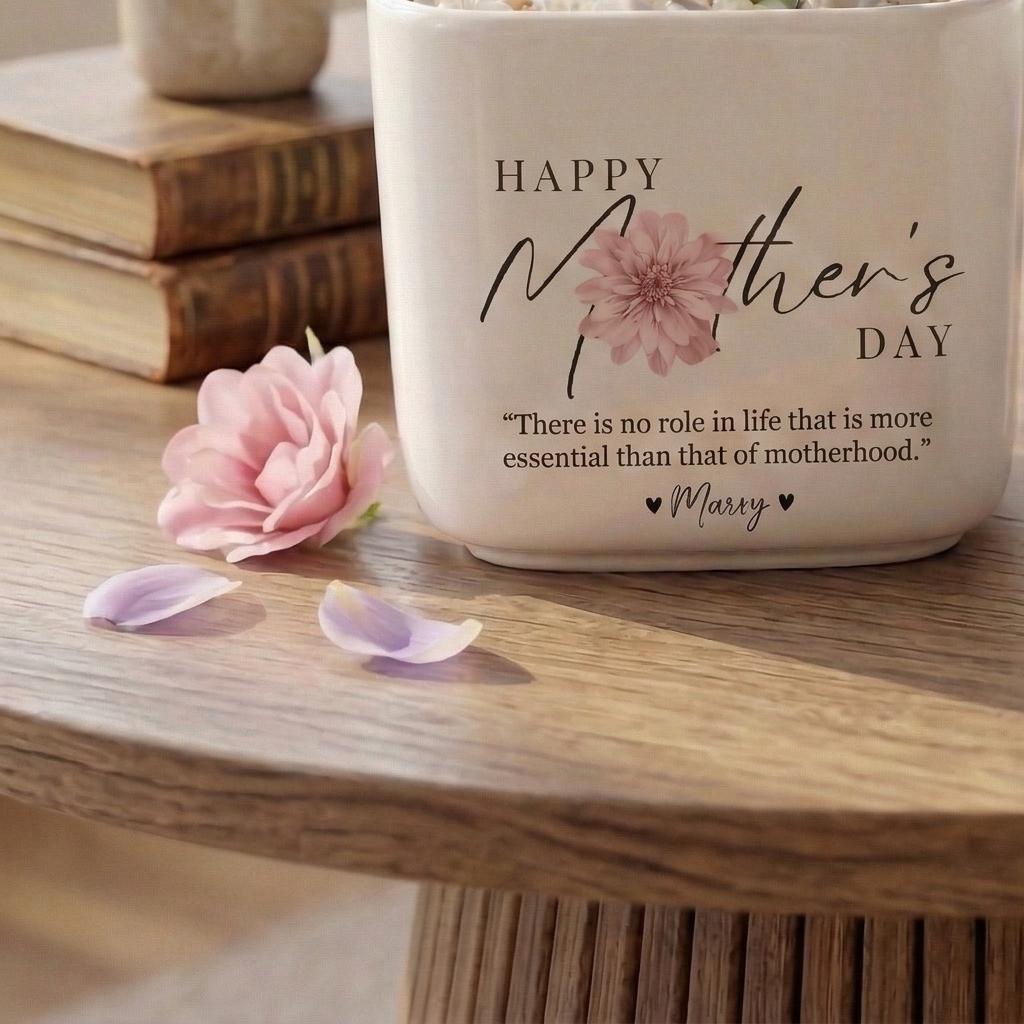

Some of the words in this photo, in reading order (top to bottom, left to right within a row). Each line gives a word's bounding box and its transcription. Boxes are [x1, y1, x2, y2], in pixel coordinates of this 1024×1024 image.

[495, 158, 662, 192] HAPPY
[480, 185, 964, 399] Mther's
[856, 324, 952, 359] DAY
[503, 412, 586, 435] “There
[594, 412, 612, 434] is
[620, 418, 651, 433] no
[659, 410, 704, 433] role
[713, 410, 736, 432] in
[743, 408, 781, 431] life
[788, 408, 836, 431] that
[843, 407, 862, 429] is
[870, 412, 932, 428] more
[503, 445, 609, 468] essential
[616, 444, 671, 466] than
[678, 443, 727, 466] that
[734, 442, 760, 465] of
[764, 438, 930, 464] motherhood.”
